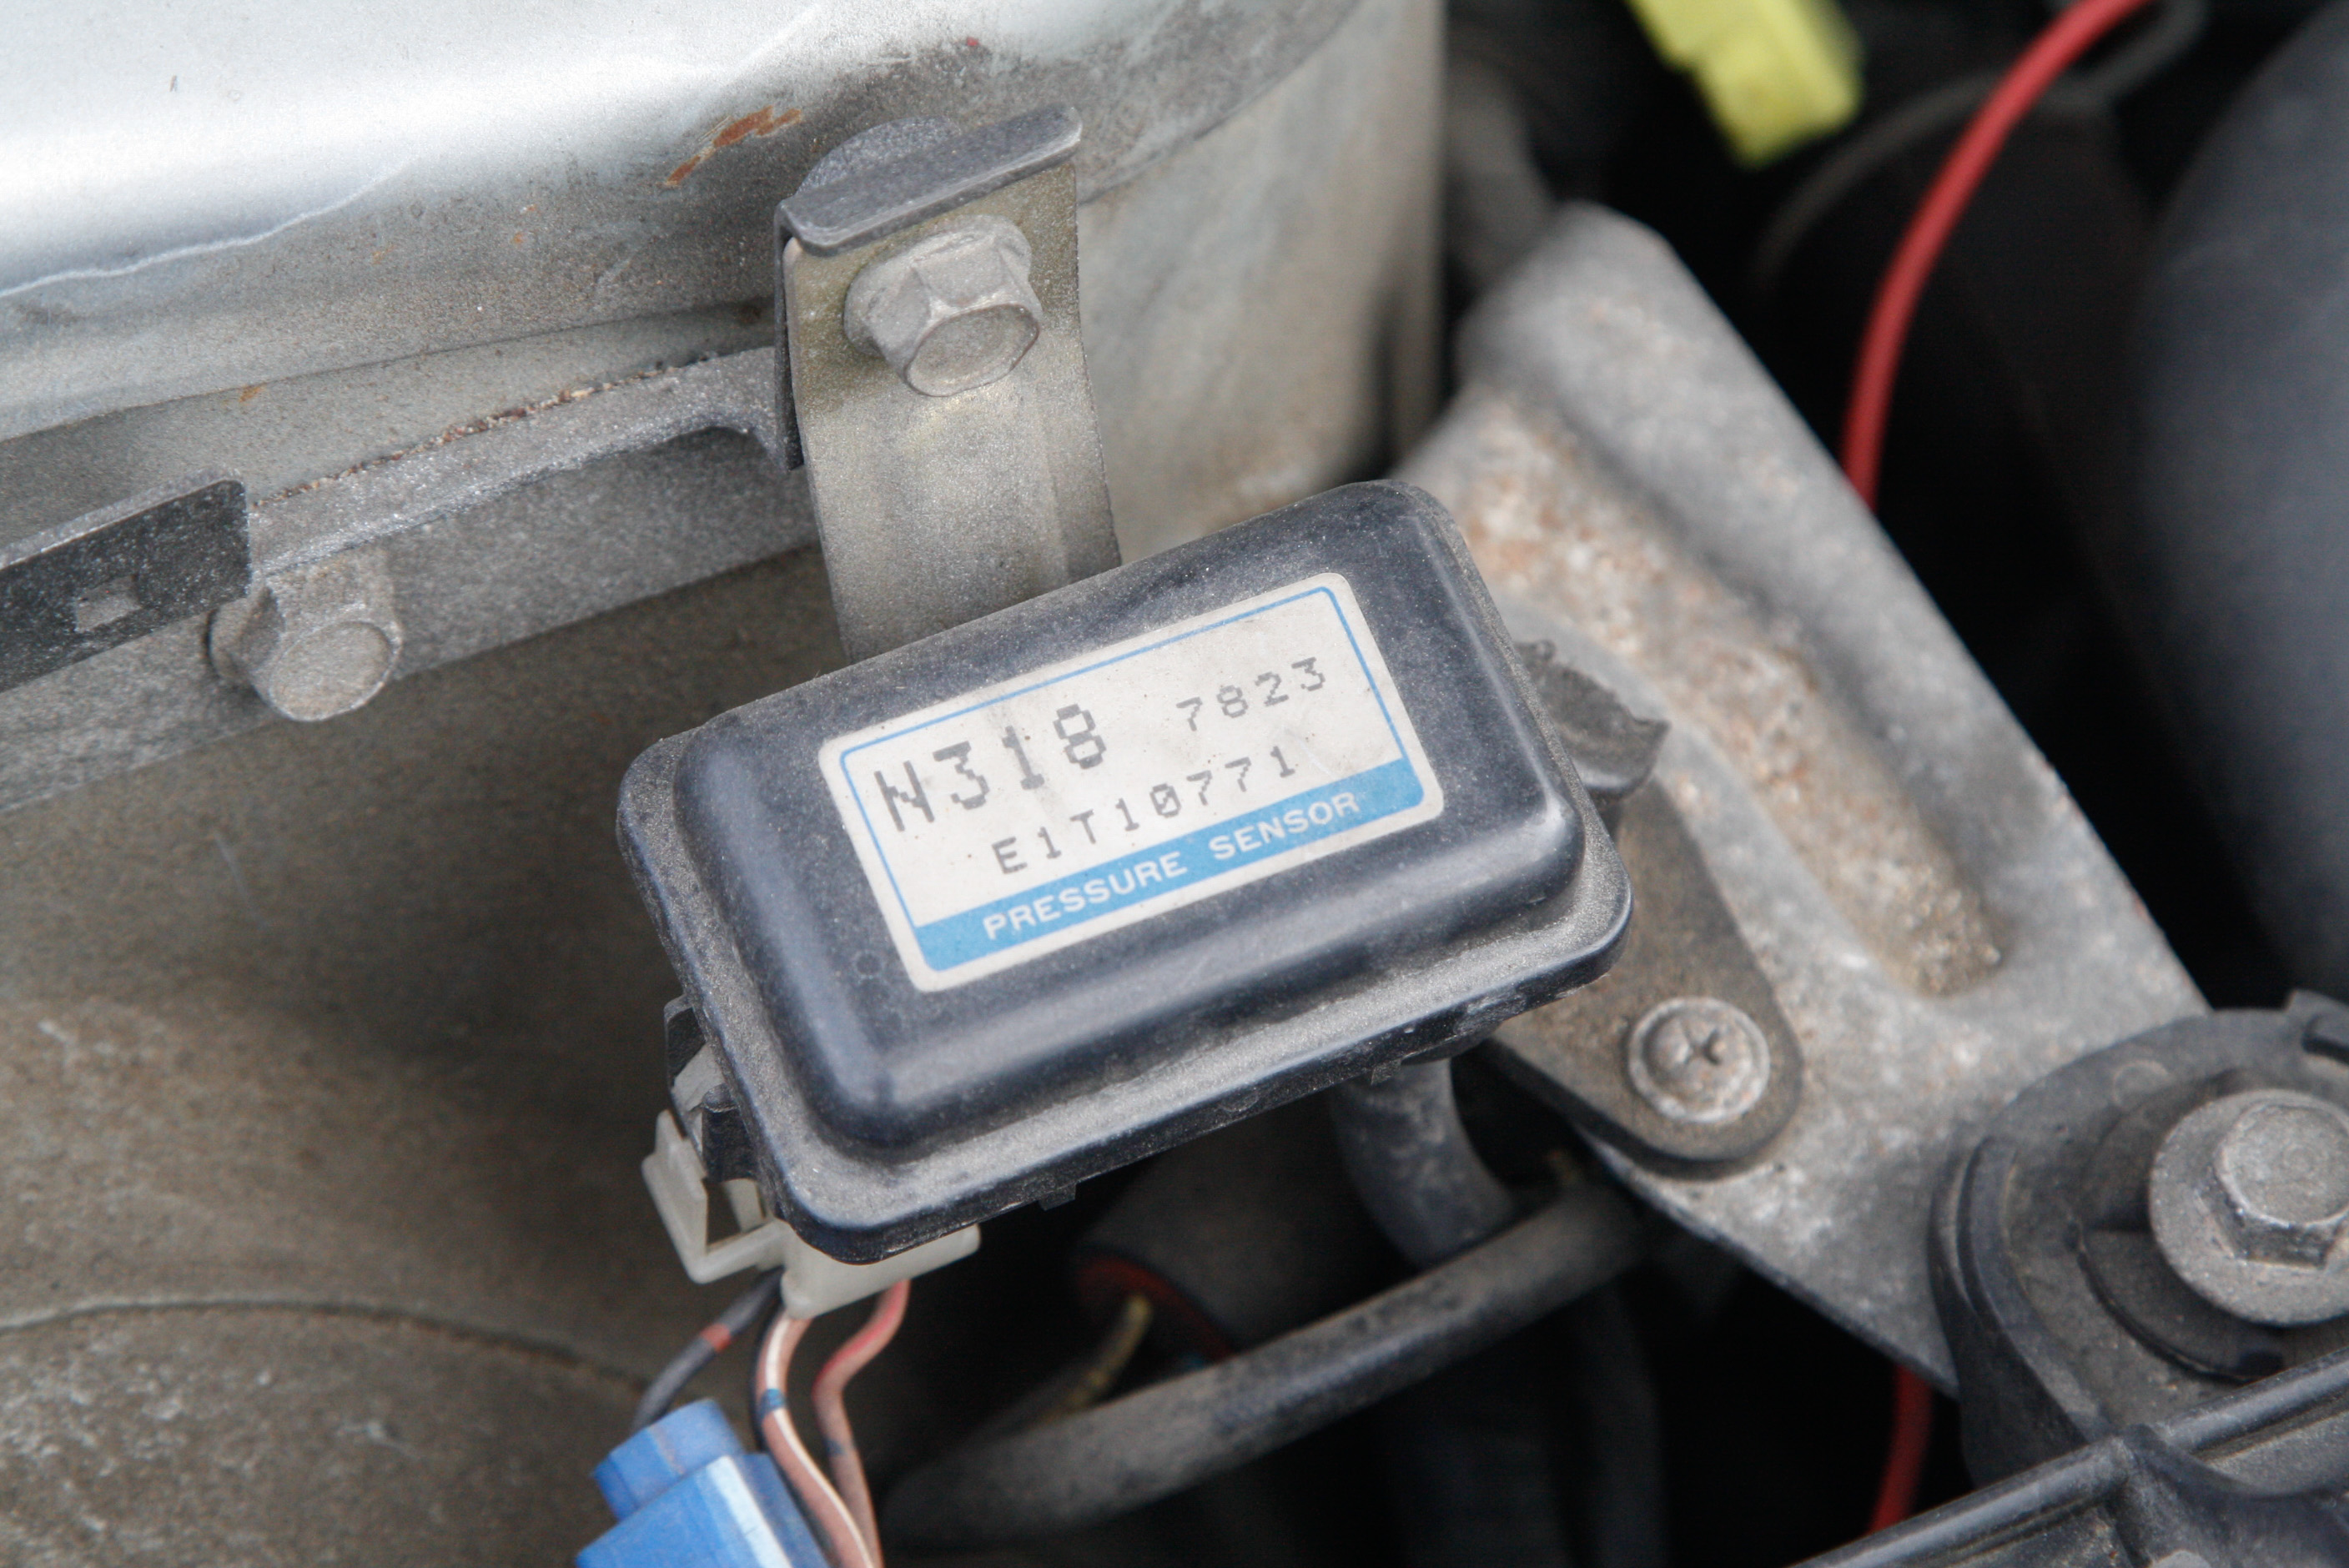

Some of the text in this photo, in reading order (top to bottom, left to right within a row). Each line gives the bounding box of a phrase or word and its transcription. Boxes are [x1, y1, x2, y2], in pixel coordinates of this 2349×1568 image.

[873, 656, 1327, 832] N318 7823
[991, 745, 1297, 875] E1T10771
[983, 792, 1360, 941] PRESSURE SENSOR
